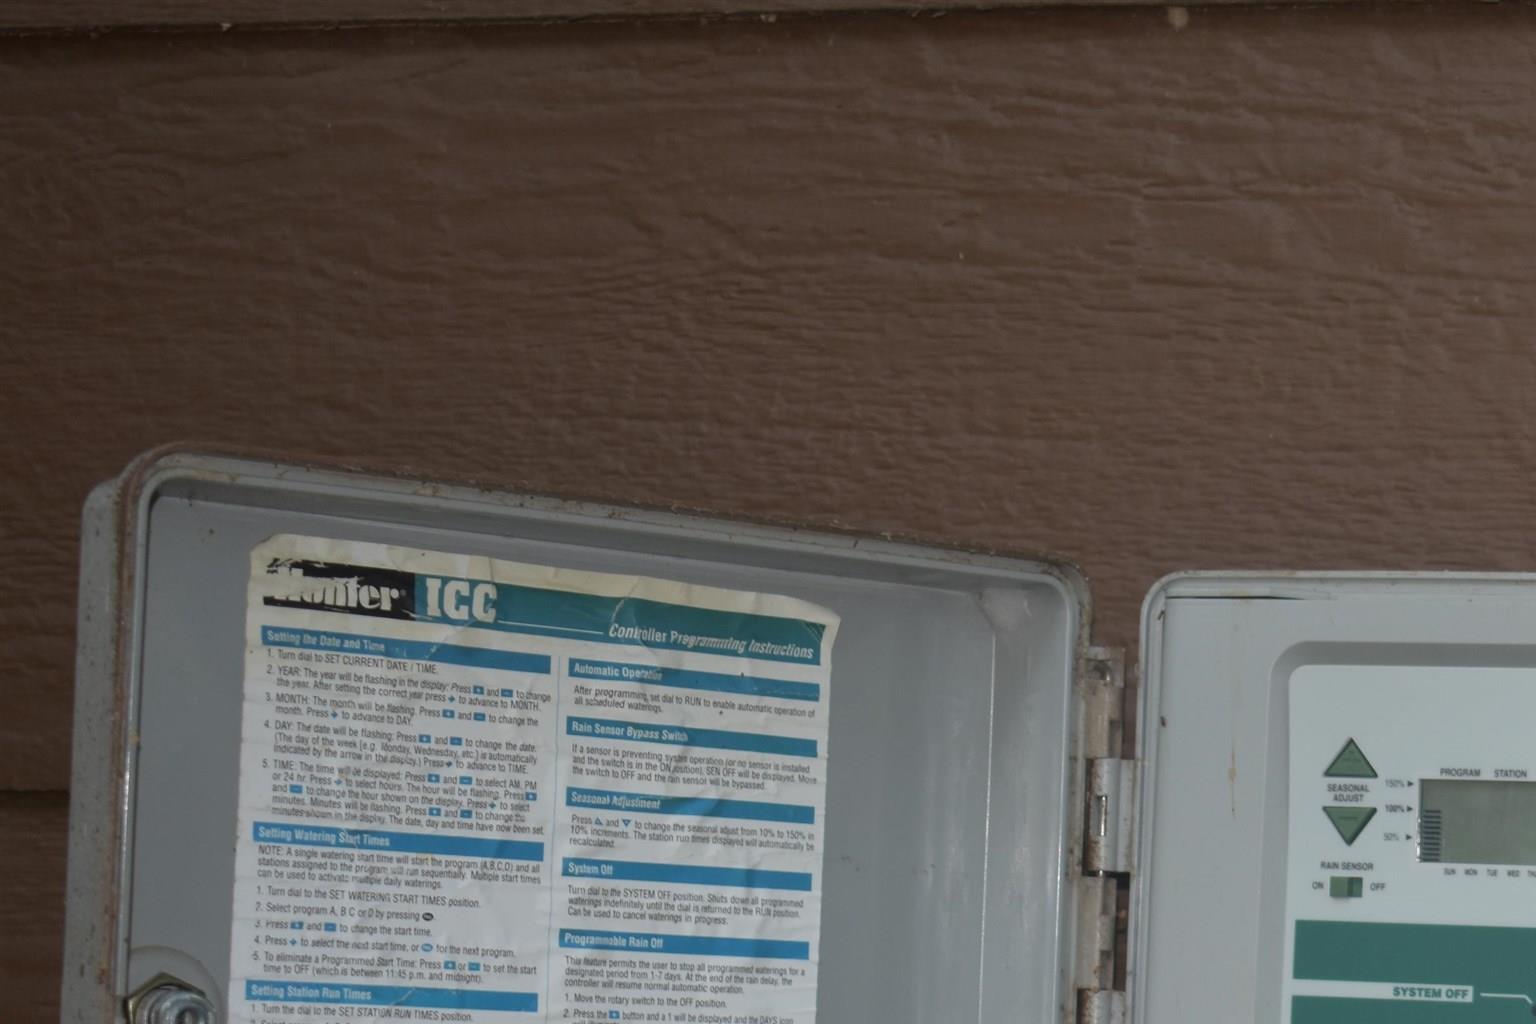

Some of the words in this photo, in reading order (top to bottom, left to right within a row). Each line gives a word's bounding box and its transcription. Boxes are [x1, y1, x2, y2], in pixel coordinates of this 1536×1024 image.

[425, 577, 497, 623] ICC
[266, 630, 300, 644] Setting
[302, 634, 316, 644] the
[319, 635, 340, 646] Date
[343, 638, 360, 649] and
[362, 640, 384, 651] Time
[608, 623, 668, 643] Controller
[748, 639, 814, 660] Instructions
[267, 648, 273, 657] 1.
[277, 649, 295, 659] Turn
[297, 651, 312, 661] dial
[313, 652, 323, 662] to
[324, 654, 339, 664] SET
[342, 655, 383, 668] CURRENT
[386, 660, 407, 671] DATE
[409, 662, 413, 671] /
[416, 663, 438, 674] TIME.
[573, 662, 619, 676] Automatic
[571, 721, 592, 733] Rain
[594, 723, 624, 735] Sensor
[626, 726, 659, 741] Bypass
[661, 729, 688, 741] Switch
[1440, 768, 1481, 778] PROGRAM
[1494, 769, 1527, 778] STATION
[1327, 783, 1370, 793] SEASONAL
[570, 792, 610, 805] Seasonal
[611, 795, 660, 811] Adjustment
[1332, 793, 1364, 802] ADJUST
[1385, 804, 1405, 813] 100%
[258, 826, 291, 841] Setting
[294, 829, 335, 845] Watering
[338, 832, 360, 844] Start
[362, 834, 389, 846] Times
[567, 862, 598, 876] System
[600, 864, 612, 875] Off
[1320, 861, 1339, 870] RAIN
[1341, 862, 1374, 871] SENSOR
[1311, 881, 1324, 890] ON
[1370, 882, 1386, 891] OFF
[256, 885, 263, 894] 1.
[267, 885, 285, 895] Turn
[287, 887, 301, 896] dial
[303, 888, 312, 897] to
[314, 888, 327, 898] the
[328, 889, 344, 899] SET
[347, 891, 391, 902] WATERING
[392, 893, 417, 904] START
[421, 895, 446, 905] TIMES
[447, 897, 479, 909] position.
[564, 933, 626, 948] Programmable
[628, 937, 648, 947] Rain
[650, 938, 663, 948] Off
[250, 984, 284, 998] Setting
[286, 986, 319, 998] Station
[321, 988, 340, 999] Run
[343, 989, 371, 1000] Times
[1392, 986, 1442, 998] SYSTEM
[1445, 988, 1469, 999] OFF
[564, 993, 570, 1001] 1.
[573, 993, 593, 1002] Move
[594, 994, 606, 1003] the
[608, 995, 629, 1006] rotary
[631, 996, 654, 1005] switch
[656, 997, 664, 1005] to
[666, 997, 678, 1006] the
[679, 998, 693, 1006] OFF
[695, 998, 727, 1009] position.
